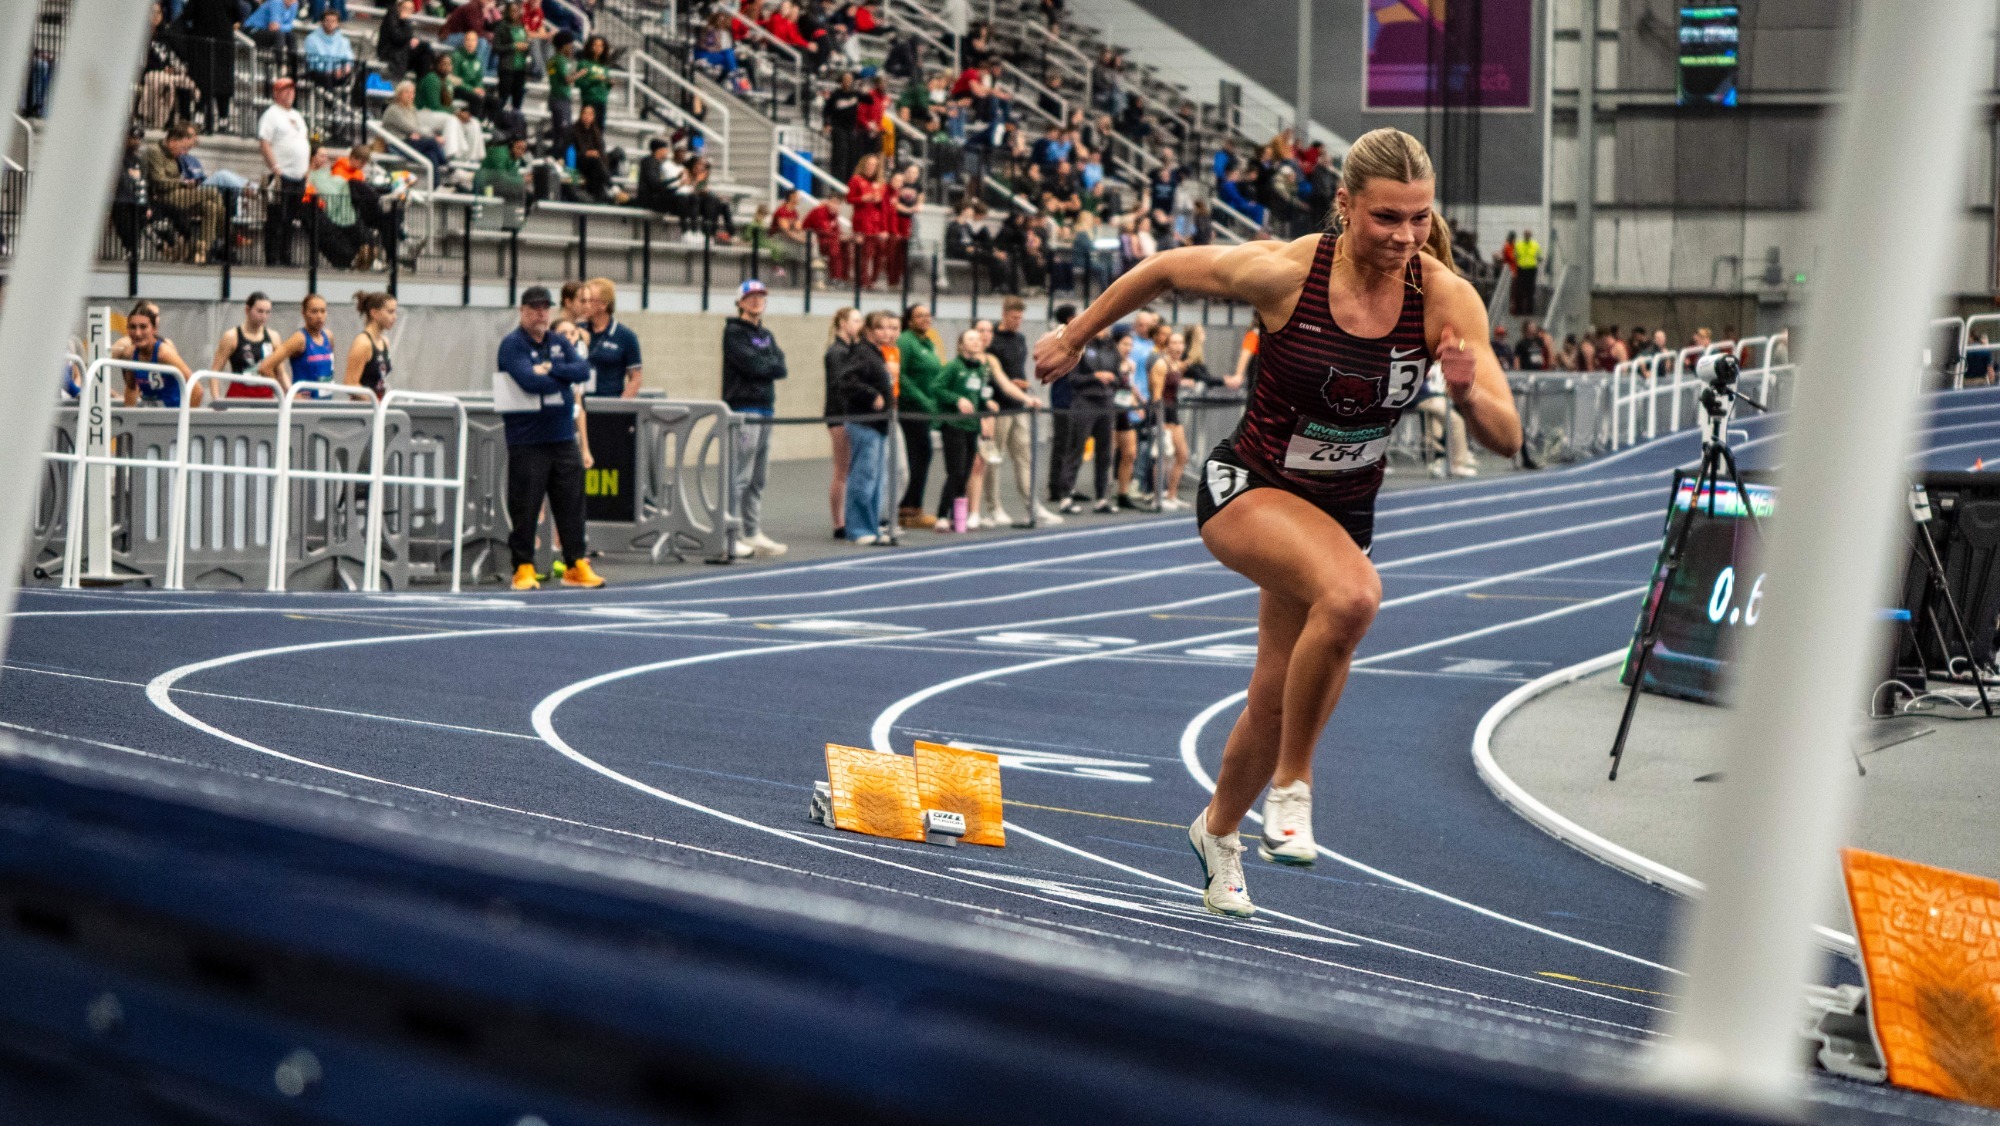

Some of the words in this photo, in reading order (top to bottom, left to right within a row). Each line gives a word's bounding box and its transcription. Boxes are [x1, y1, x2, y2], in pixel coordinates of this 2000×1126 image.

[1390, 364, 1419, 407] 3
[1303, 429, 1384, 443] INVITATIONAL
[1307, 422, 1385, 437] RIVERFRONT
[1309, 443, 1368, 462] 254
[1216, 464, 1238, 499] 3
